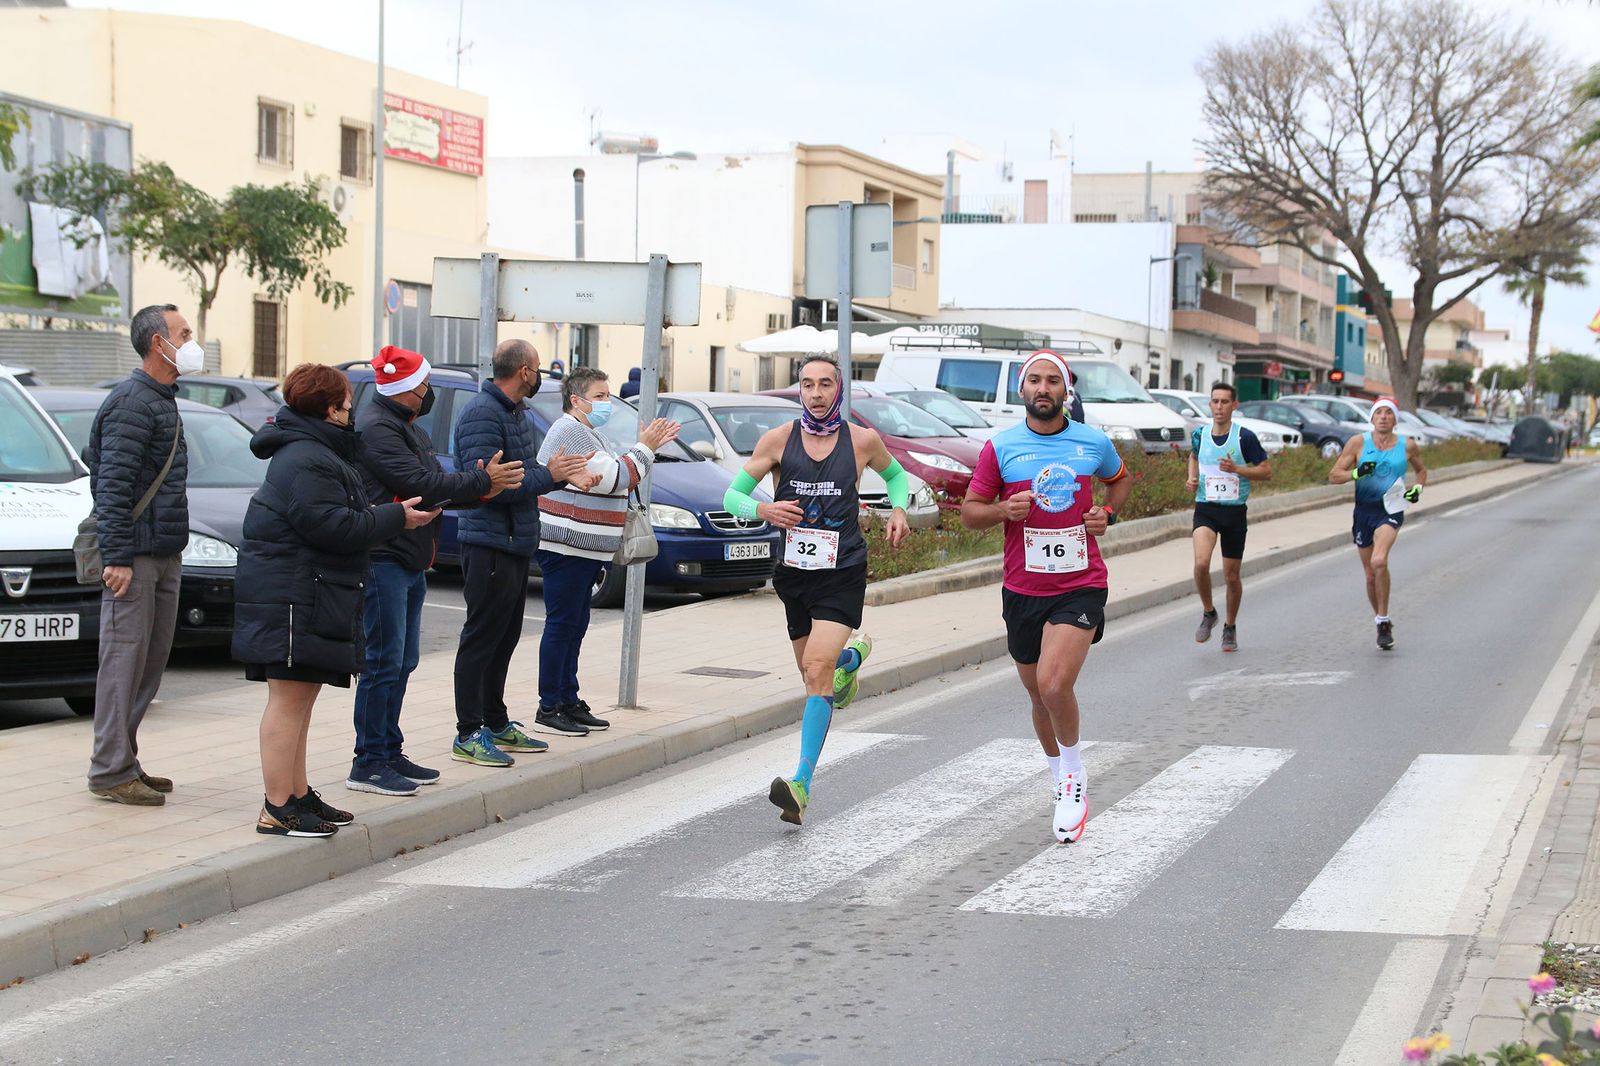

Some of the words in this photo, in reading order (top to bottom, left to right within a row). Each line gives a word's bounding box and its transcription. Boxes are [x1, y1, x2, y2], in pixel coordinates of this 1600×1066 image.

[790, 480, 834, 489] CAPTAIN
[1214, 484, 1227, 492] 13
[796, 488, 842, 496] AMERICA
[730, 545, 751, 558] 4363
[797, 541, 817, 556] 32
[1042, 544, 1066, 557] 16
[0, 618, 26, 638] 78
[35, 617, 74, 637] HRP
